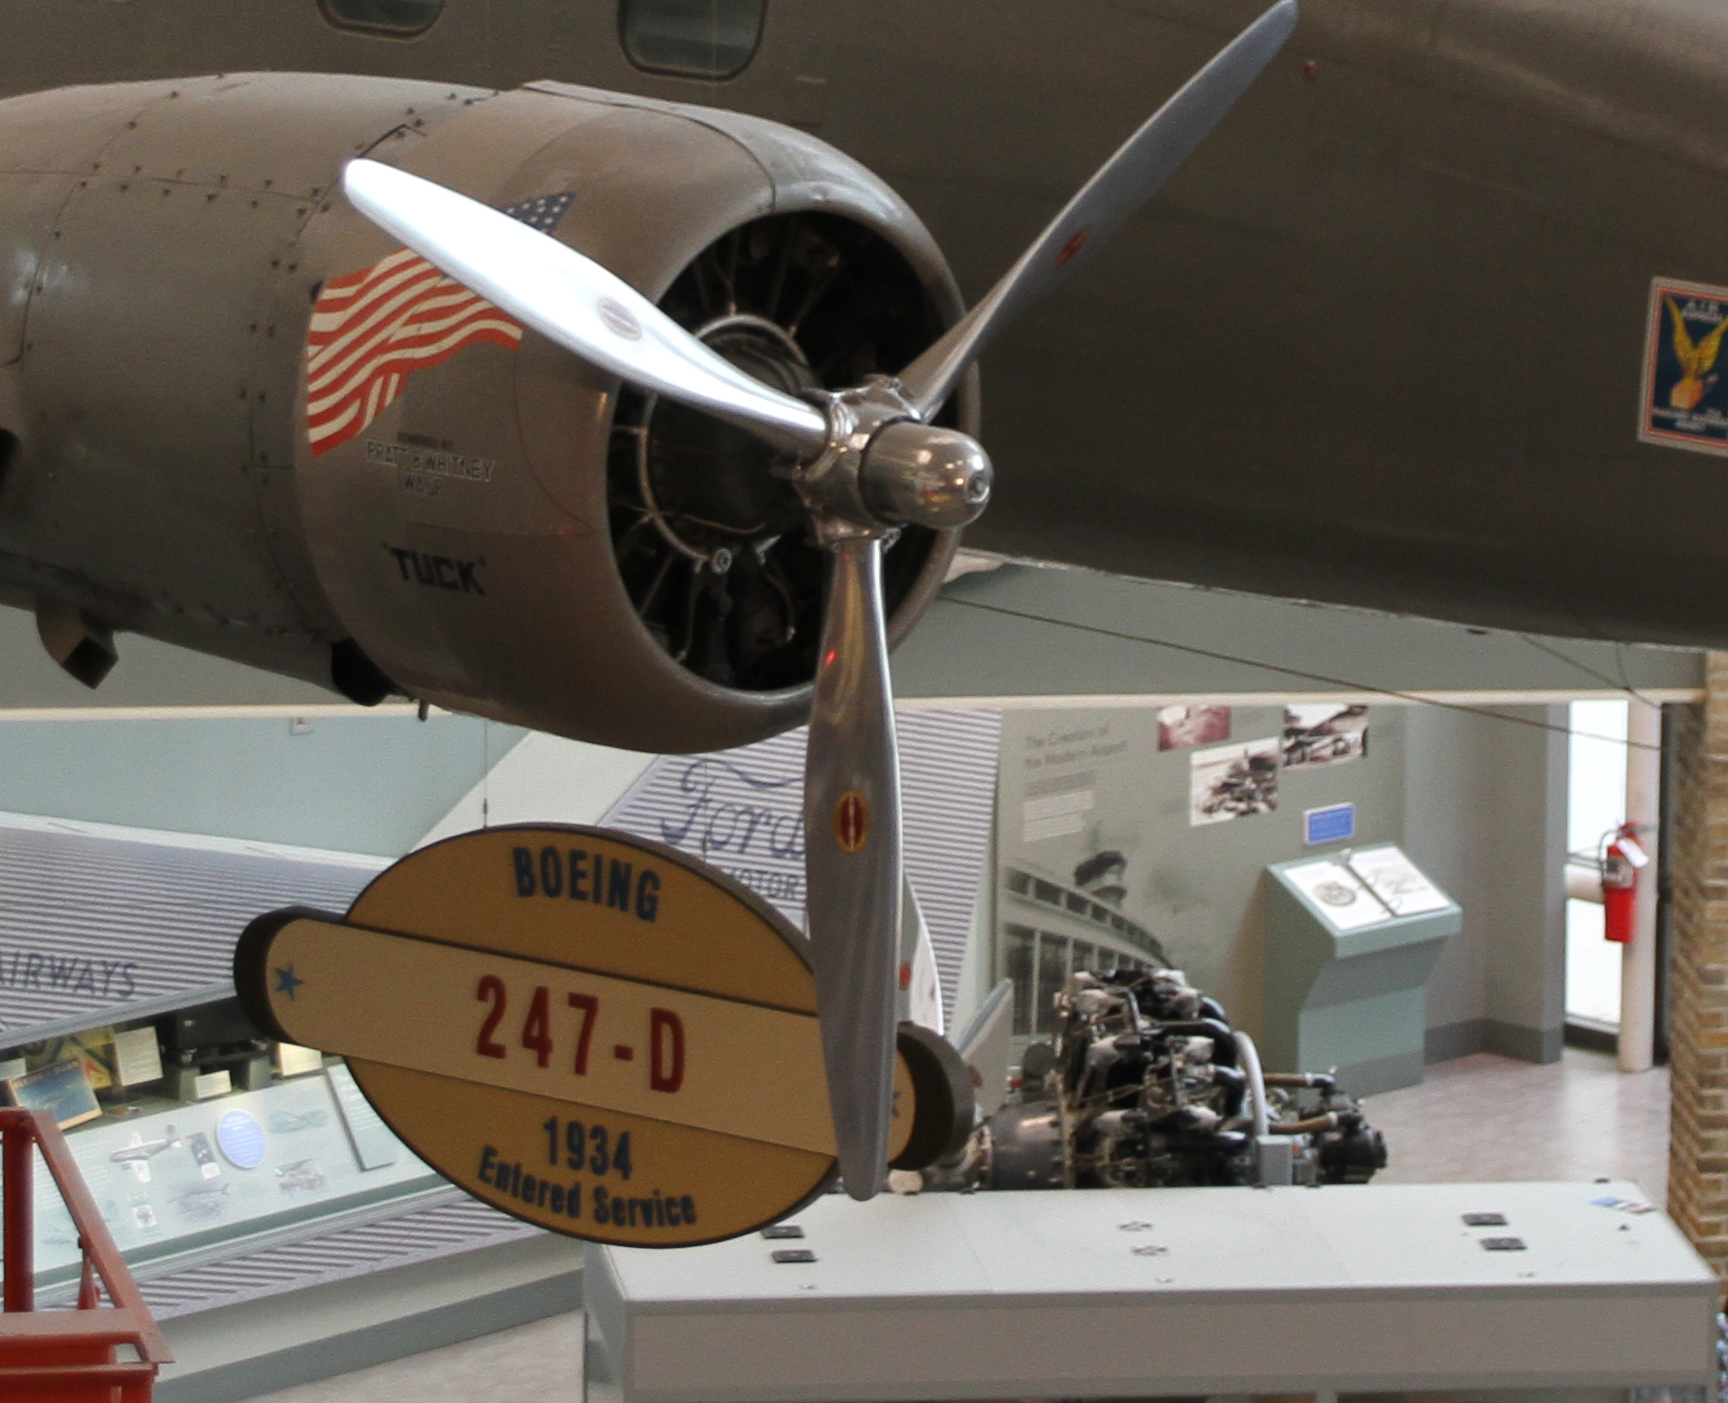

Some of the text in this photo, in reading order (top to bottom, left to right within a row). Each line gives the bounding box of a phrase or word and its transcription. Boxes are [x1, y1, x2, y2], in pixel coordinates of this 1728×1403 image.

[366, 440, 409, 466] PRATT
[424, 452, 496, 483] WHITNEY
[511, 846, 662, 924] BOEING
[475, 974, 686, 1095] 247-D
[477, 1145, 697, 1228] Entered Service
[543, 1115, 633, 1181] 1934
